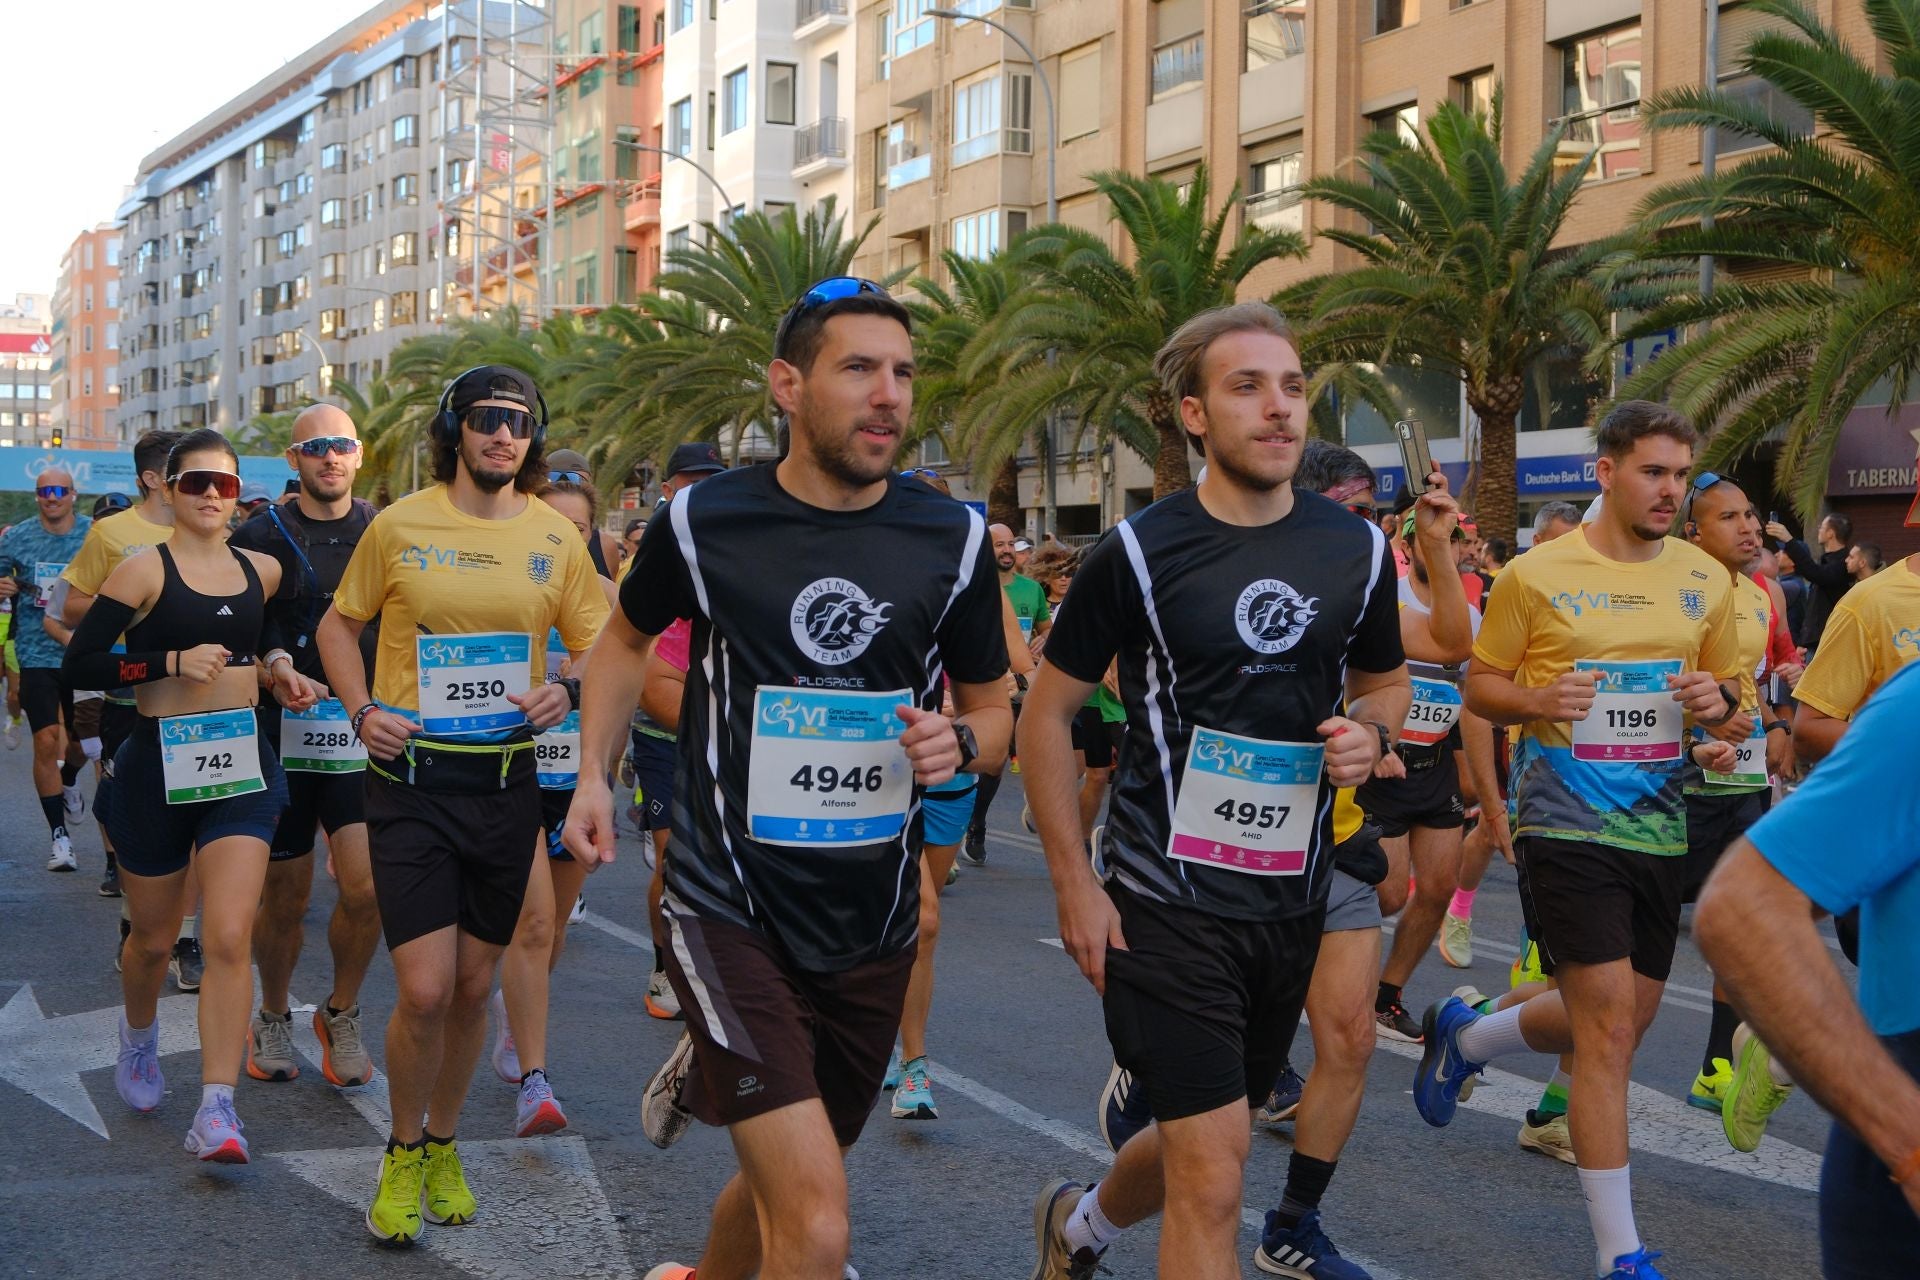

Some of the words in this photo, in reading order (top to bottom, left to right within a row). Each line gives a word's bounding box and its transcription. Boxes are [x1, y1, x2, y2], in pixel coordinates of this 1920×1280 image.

[1525, 472, 1560, 485] Deutsche
[1561, 470, 1581, 482] Bank
[1847, 467, 1920, 488] TABERNA
[794, 581, 857, 624] RUNNING
[1238, 581, 1289, 622] RUNNING
[447, 646, 465, 659] VI
[1256, 640, 1289, 651] TEAM
[814, 649, 852, 662] TEAM
[1606, 671, 1623, 685] VI
[446, 679, 505, 701] 2530
[464, 702, 490, 710] BROSKY
[1409, 703, 1453, 724] 3162
[801, 706, 828, 727] VI
[1606, 709, 1657, 728] 1196
[187, 724, 203, 736] VI
[841, 728, 865, 738] 2025
[303, 732, 349, 747] 2288
[536, 744, 571, 760] 882
[1735, 748, 1752, 762] 90
[195, 752, 233, 772] 742
[1231, 750, 1255, 770] VI
[790, 765, 883, 793] 4946
[821, 799, 857, 808] Alfonso
[1214, 798, 1290, 829] 4957
[1241, 831, 1263, 840] AHID
